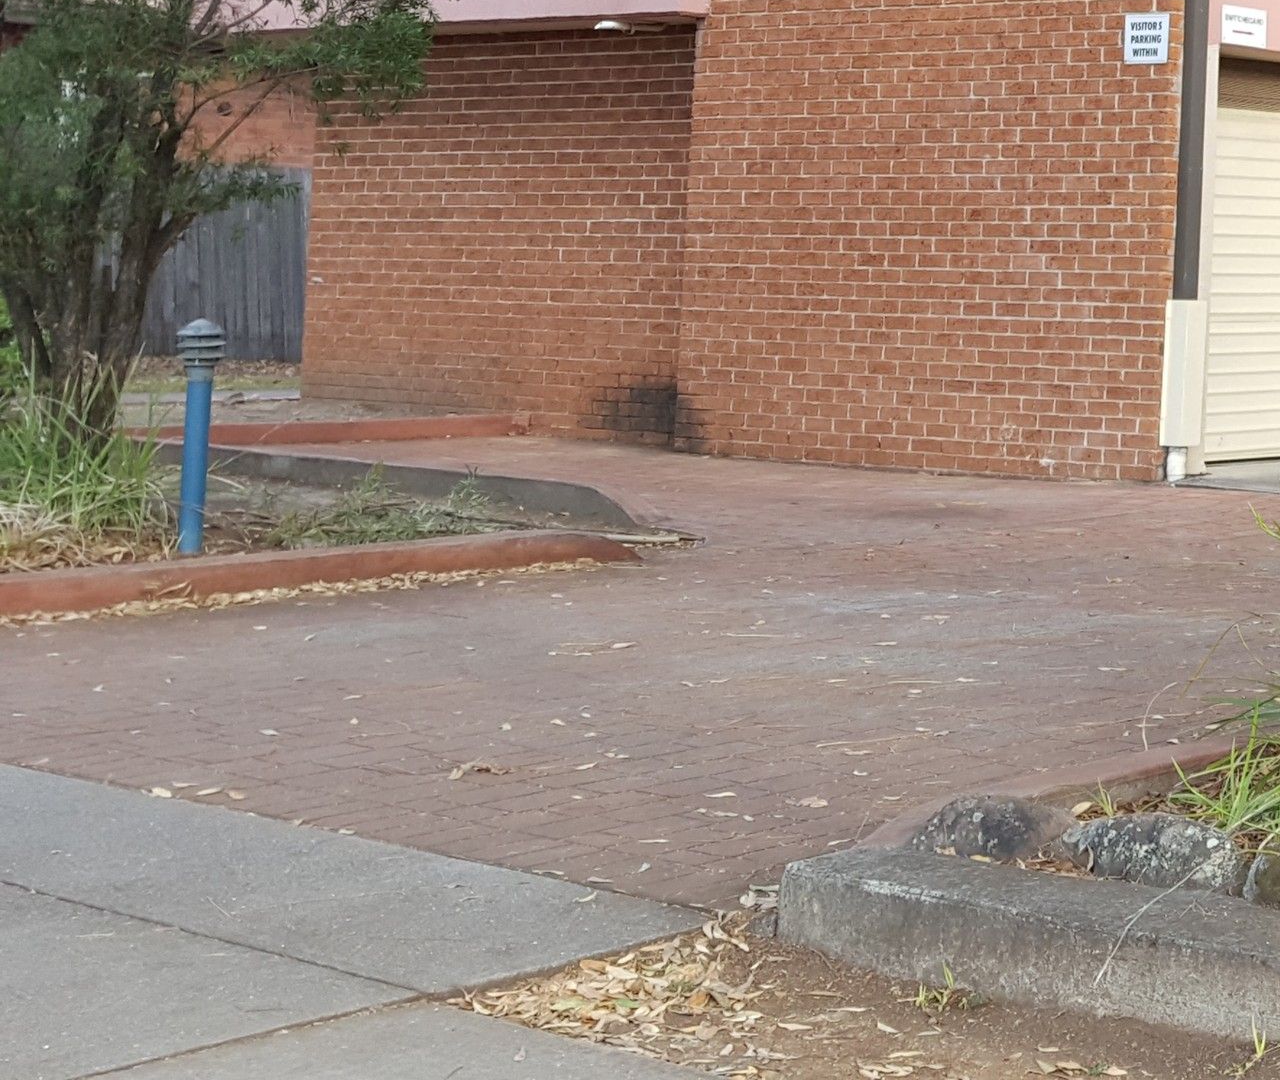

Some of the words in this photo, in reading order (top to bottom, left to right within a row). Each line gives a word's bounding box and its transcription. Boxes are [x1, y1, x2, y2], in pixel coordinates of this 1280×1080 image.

[1130, 21, 1163, 31] VISITORS
[1130, 34, 1162, 44] PARKING
[1132, 47, 1159, 57] WITHIN
